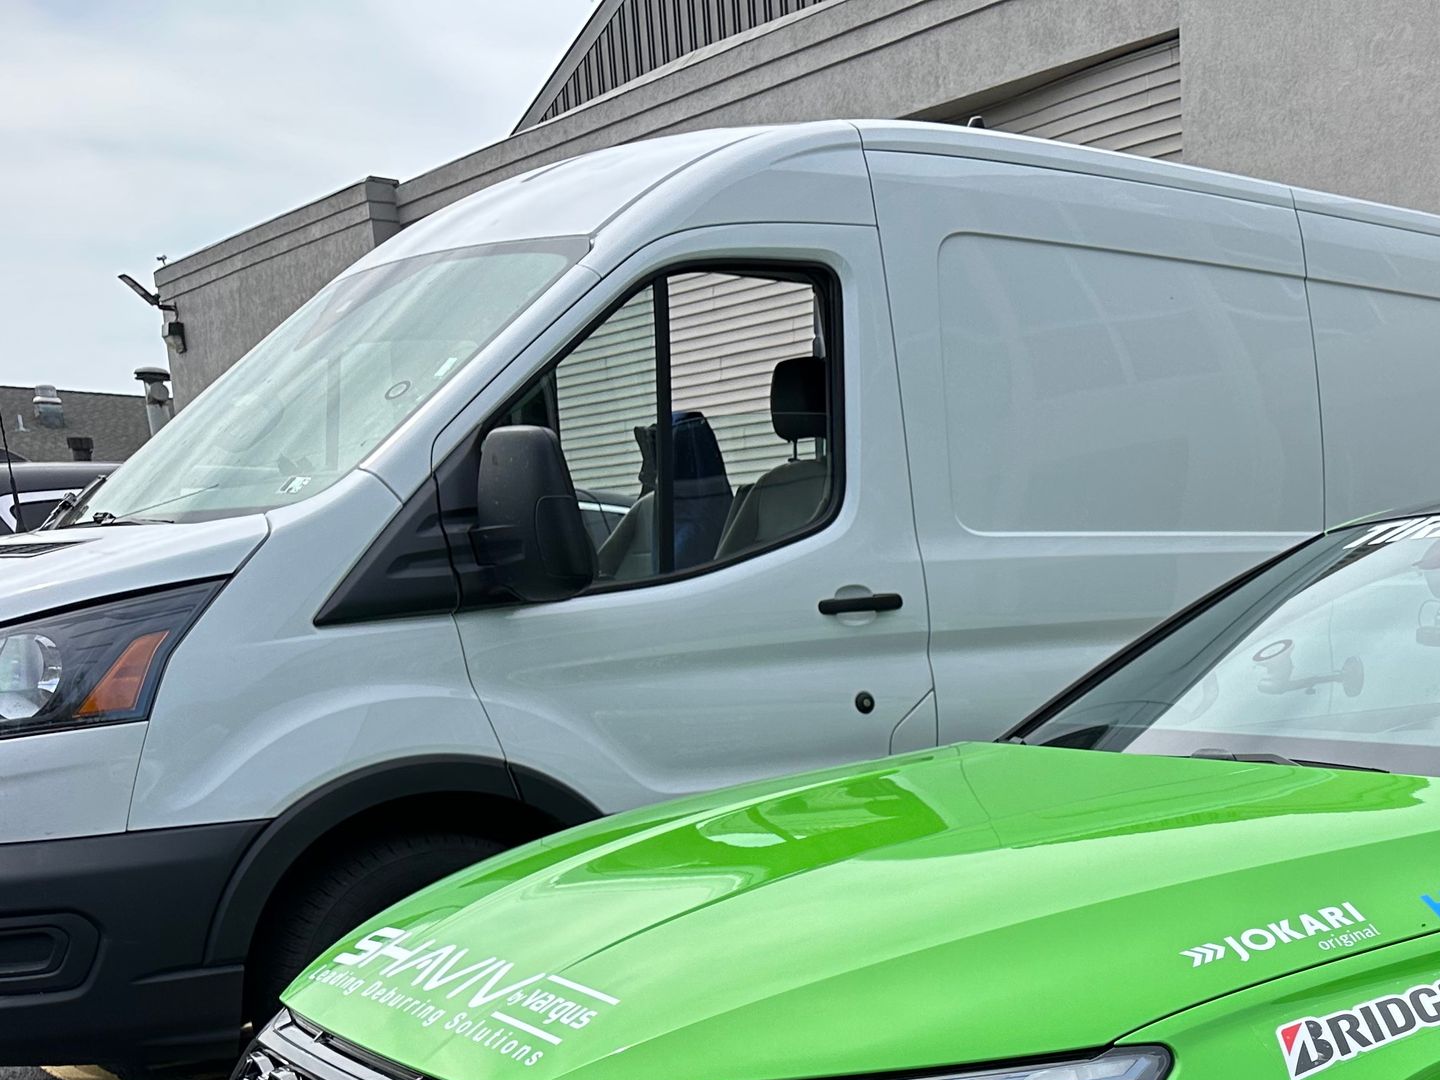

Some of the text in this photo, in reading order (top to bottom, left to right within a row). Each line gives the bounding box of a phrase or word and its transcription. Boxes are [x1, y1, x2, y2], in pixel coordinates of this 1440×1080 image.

[333, 926, 546, 1008] SHAVIV
[506, 989, 528, 1006] by
[1224, 901, 1367, 962] JOKARI
[1318, 923, 1383, 952] original
[309, 964, 544, 1066] Leading Deburring Solutions
